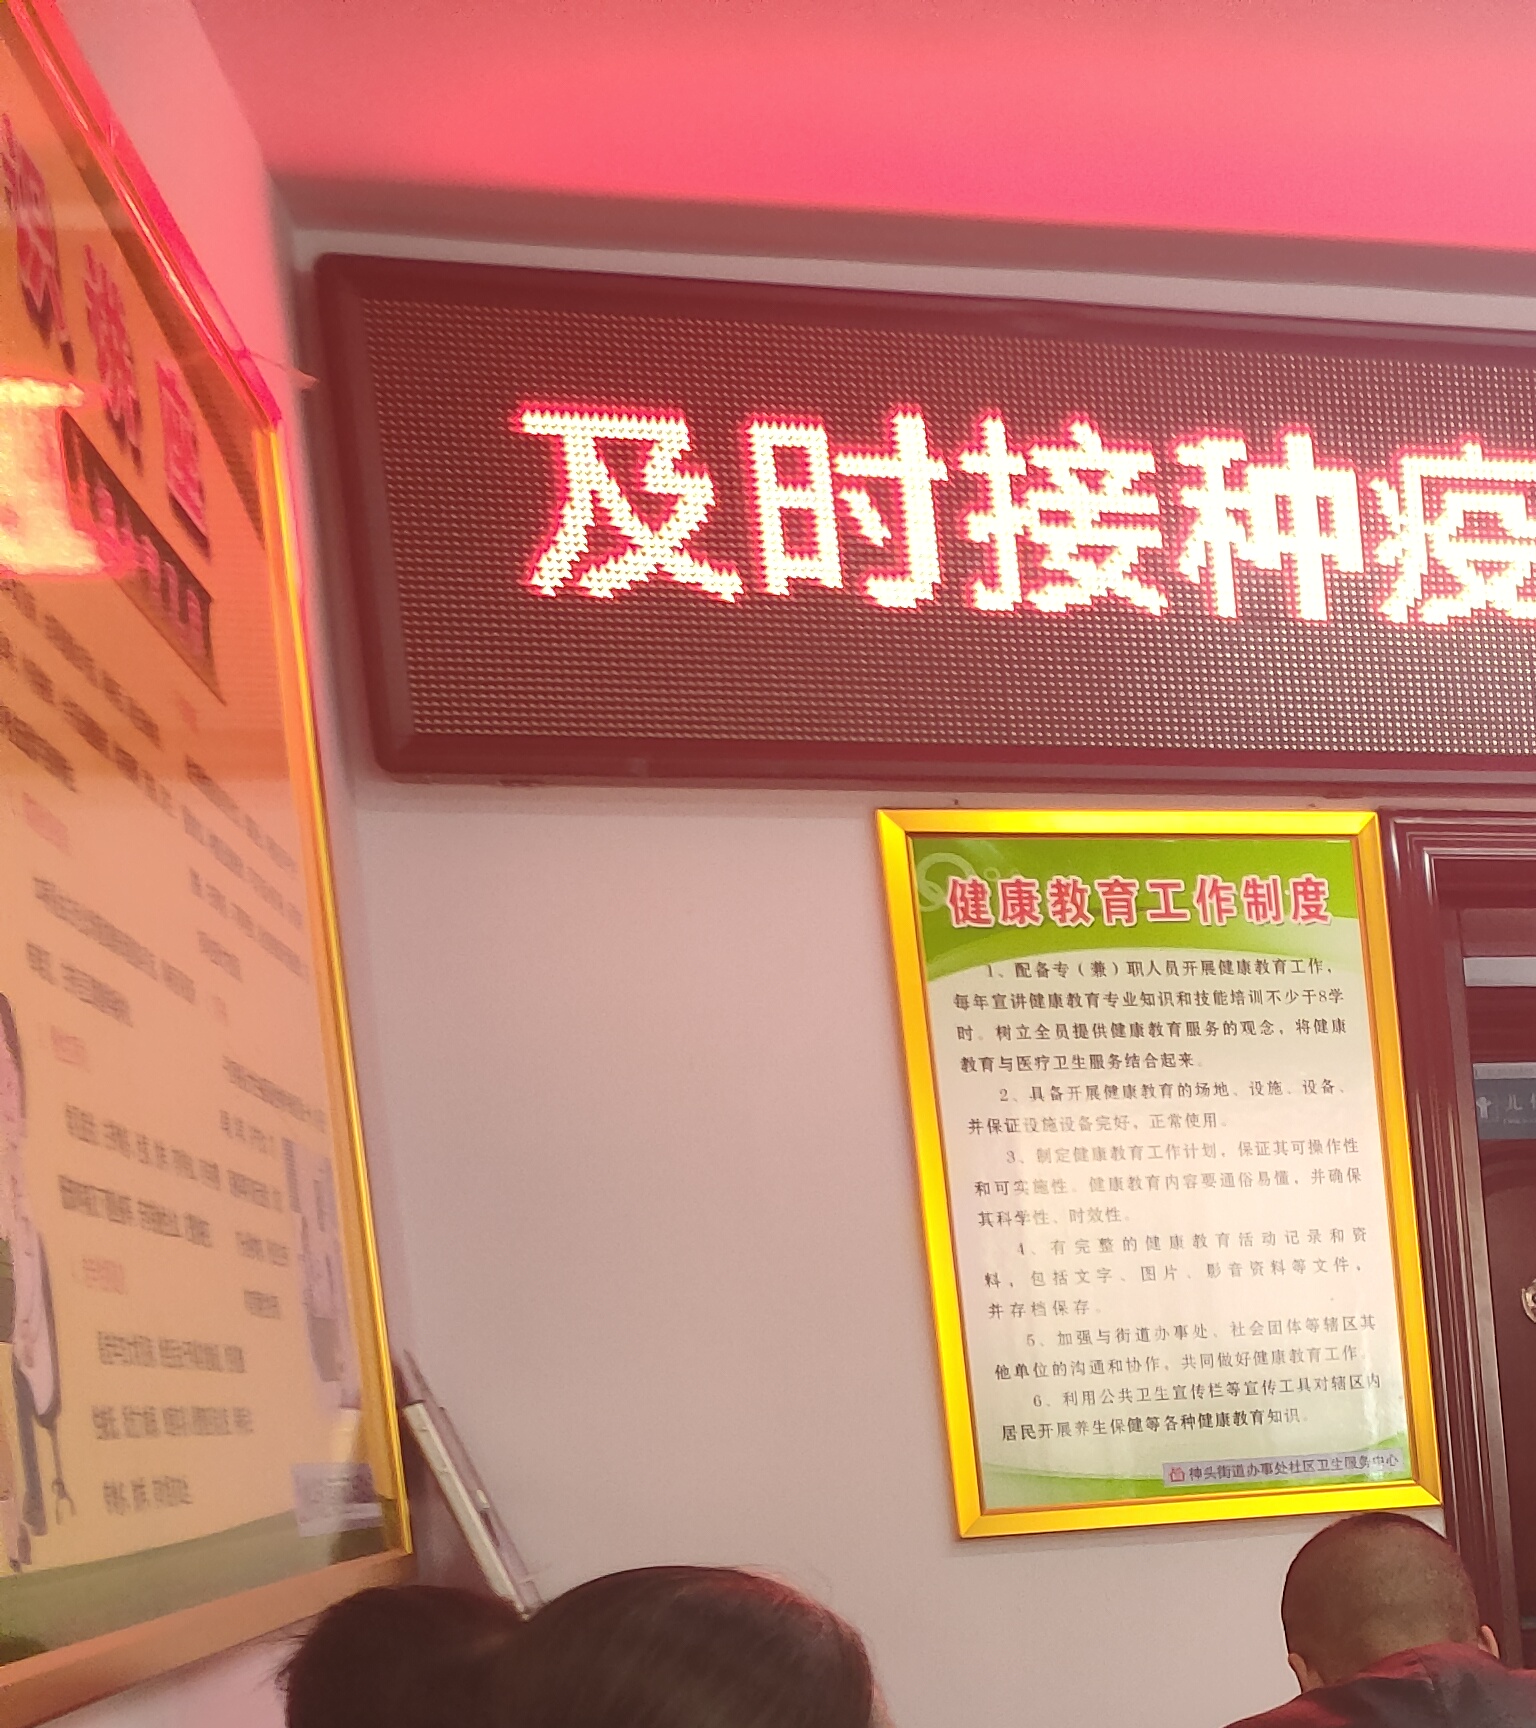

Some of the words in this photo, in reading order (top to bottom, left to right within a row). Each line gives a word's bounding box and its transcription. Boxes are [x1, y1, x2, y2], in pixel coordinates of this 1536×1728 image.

[946, 873, 1333, 928] 健康教育工作制度
[1188, 1453, 1400, 1482] 神头街道办事处社区卫生服务中心
